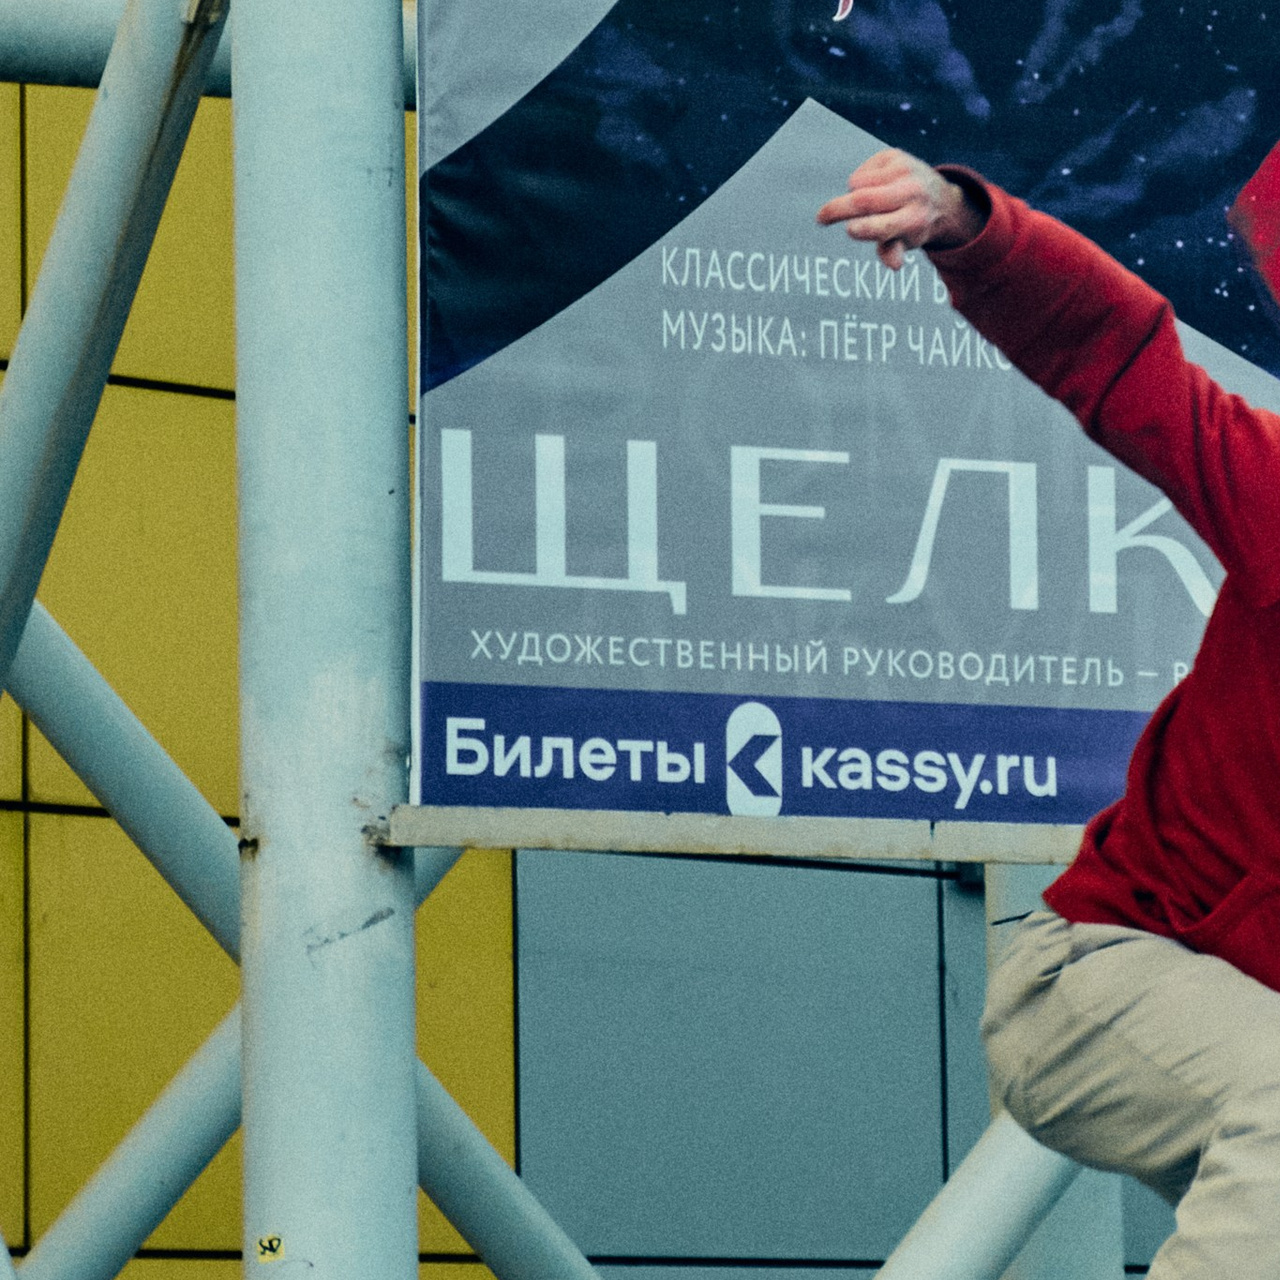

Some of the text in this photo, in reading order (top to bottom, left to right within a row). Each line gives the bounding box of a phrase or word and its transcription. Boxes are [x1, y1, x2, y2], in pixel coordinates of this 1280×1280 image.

[661, 245, 921, 303] КЛАССИЧЕСКИЙ
[661, 308, 808, 358] МУЗЫКА:
[818, 313, 898, 363] ПЁТР
[470, 629, 829, 676] ХУДОЖЕСТВЕННЫЙ
[842, 646, 1124, 688] РУКОВОДИТЕЛЬ
[444, 716, 706, 785] Билеты
[800, 744, 1058, 810] kassy.ru
